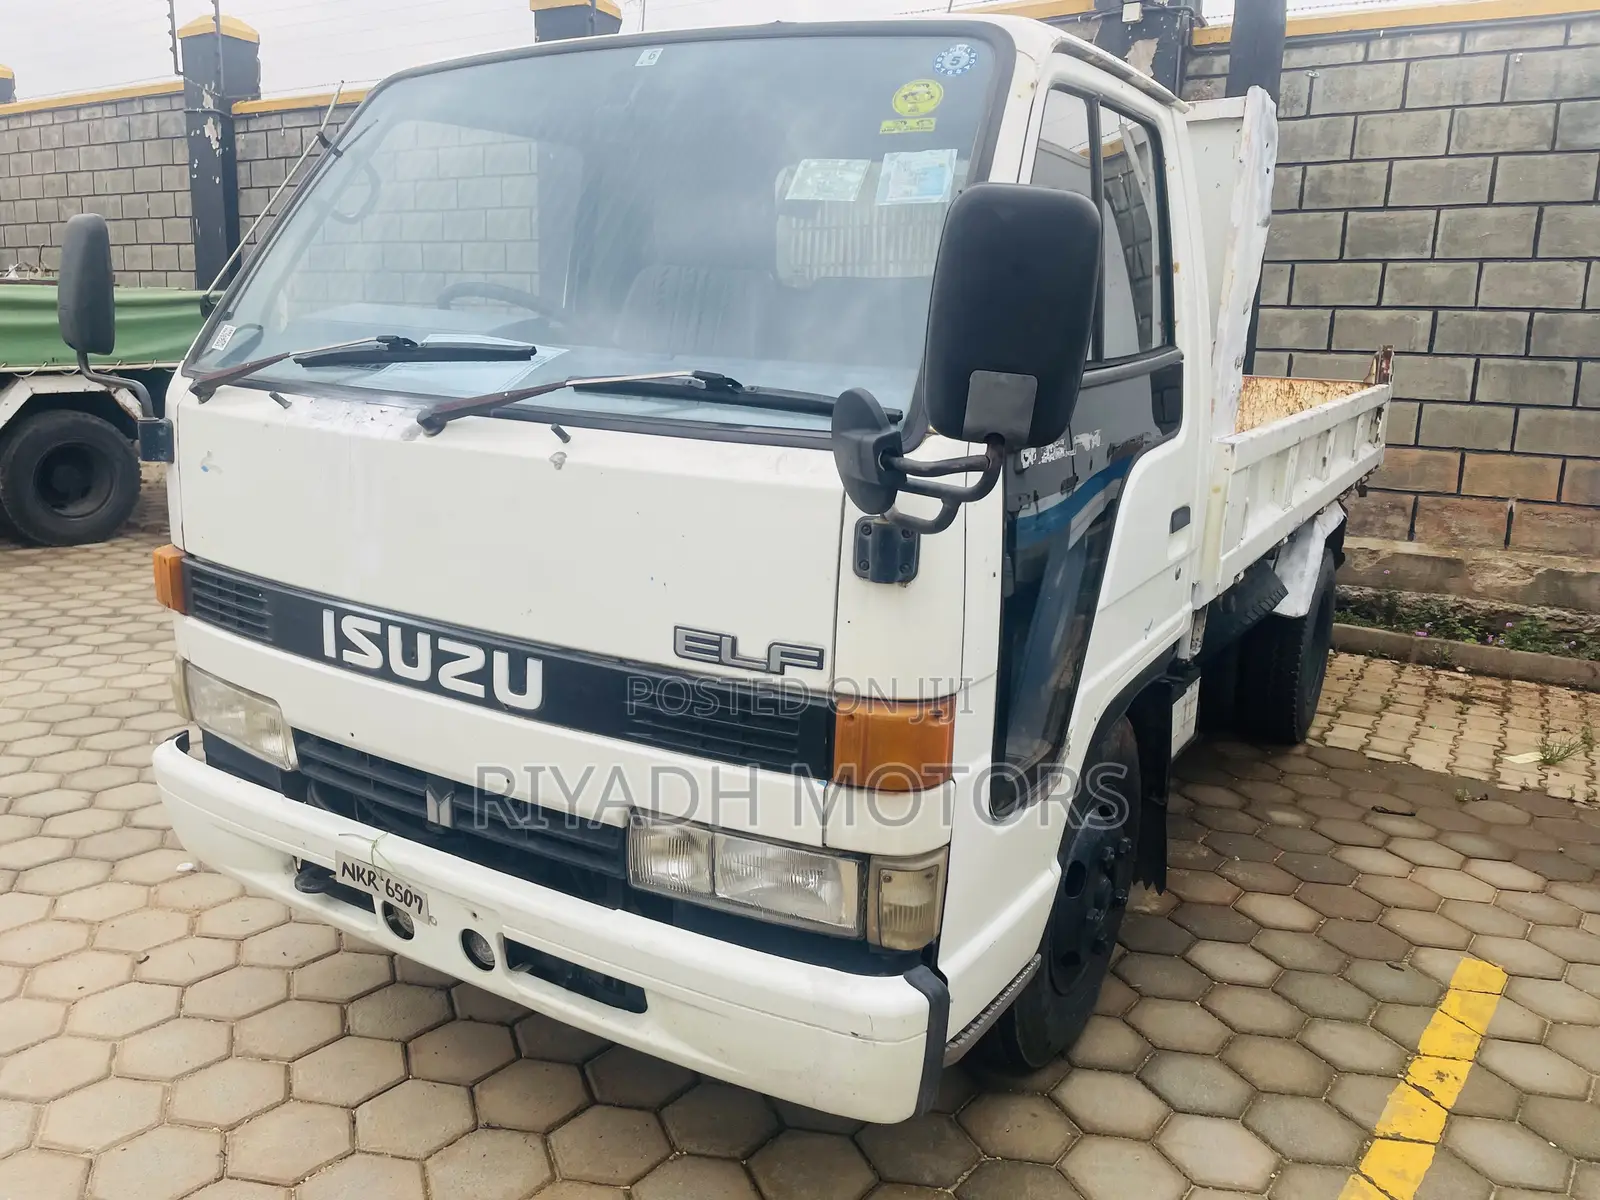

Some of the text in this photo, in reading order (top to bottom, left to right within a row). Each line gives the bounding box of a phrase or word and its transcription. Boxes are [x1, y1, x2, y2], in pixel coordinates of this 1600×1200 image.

[949, 56, 961, 66] 5
[323, 609, 543, 710] ISUZU
[674, 625, 824, 675] ELF
[342, 861, 423, 914] NKR 6507
